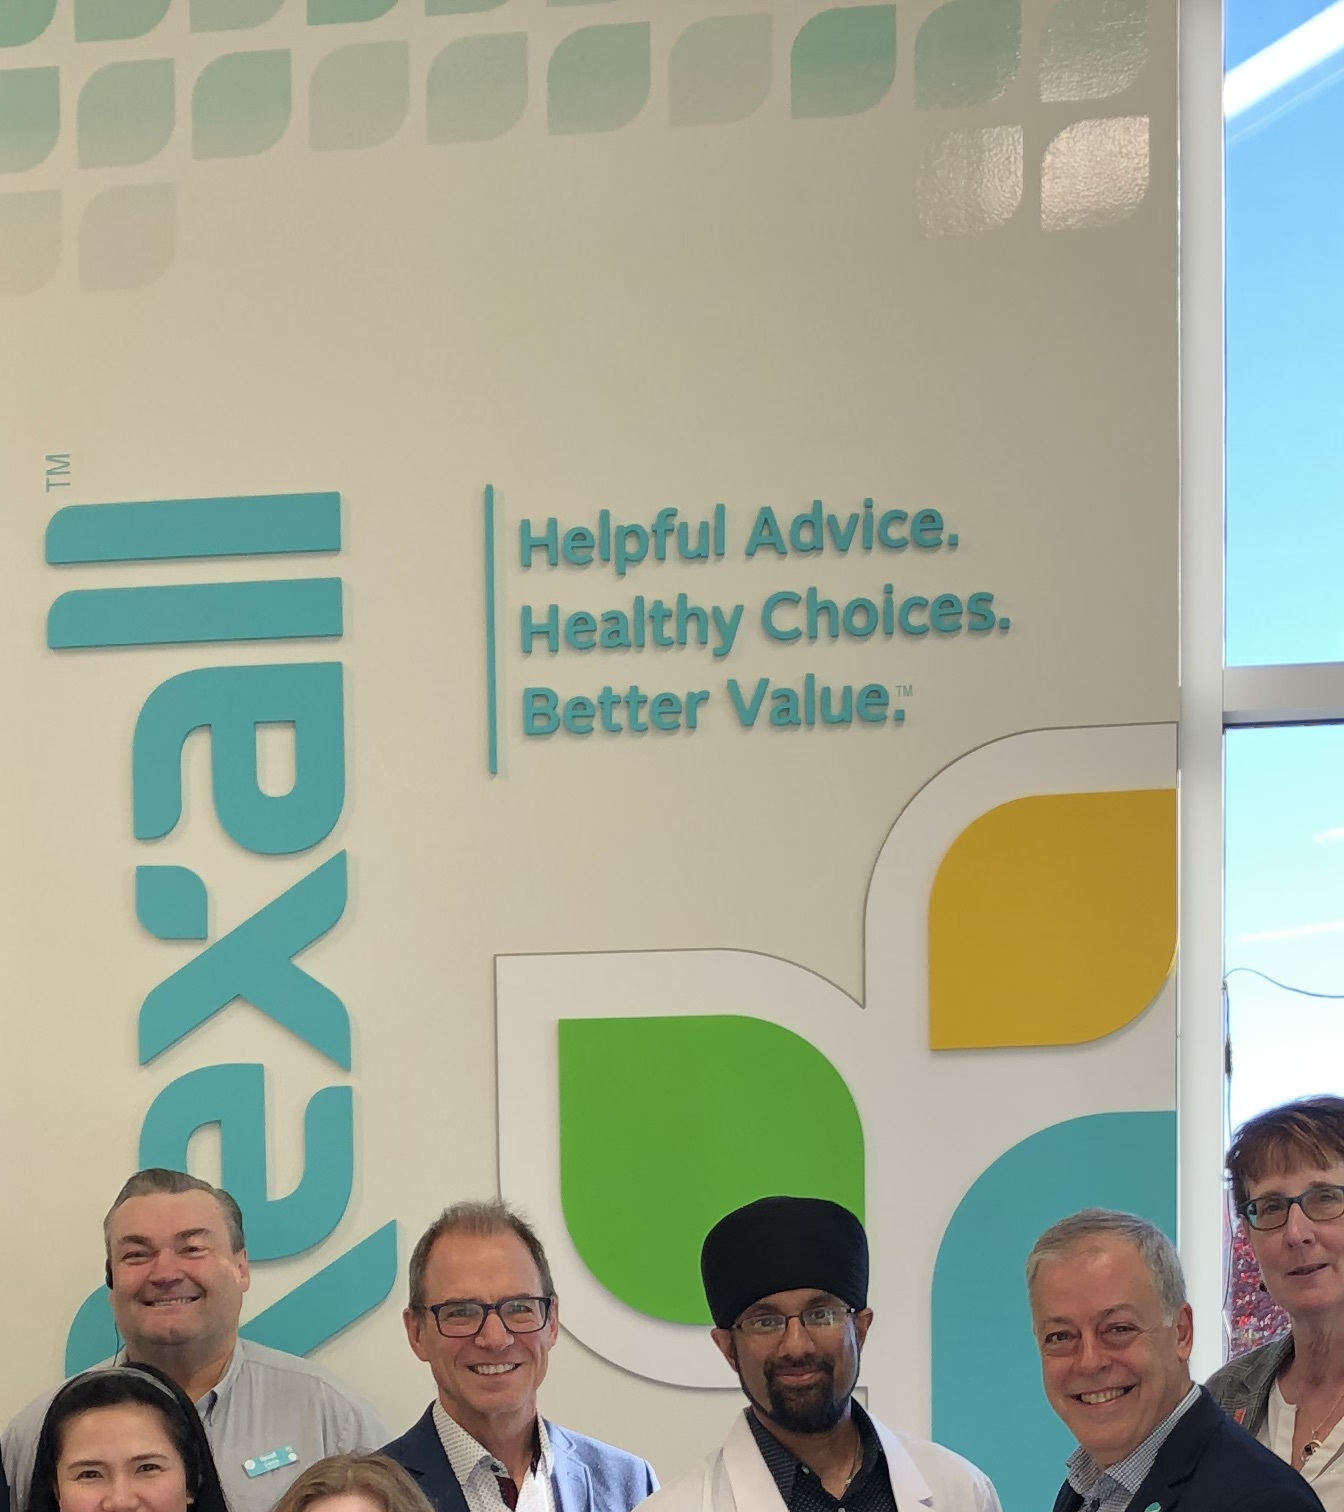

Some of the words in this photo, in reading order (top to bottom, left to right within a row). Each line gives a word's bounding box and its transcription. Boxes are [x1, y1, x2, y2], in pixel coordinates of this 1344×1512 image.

[519, 504, 726, 576] Helpful
[745, 498, 959, 556] Advice.
[521, 593, 744, 657] Healthy
[761, 584, 1010, 641] Choices.
[523, 685, 710, 736] Better
[727, 673, 906, 727] Value.
